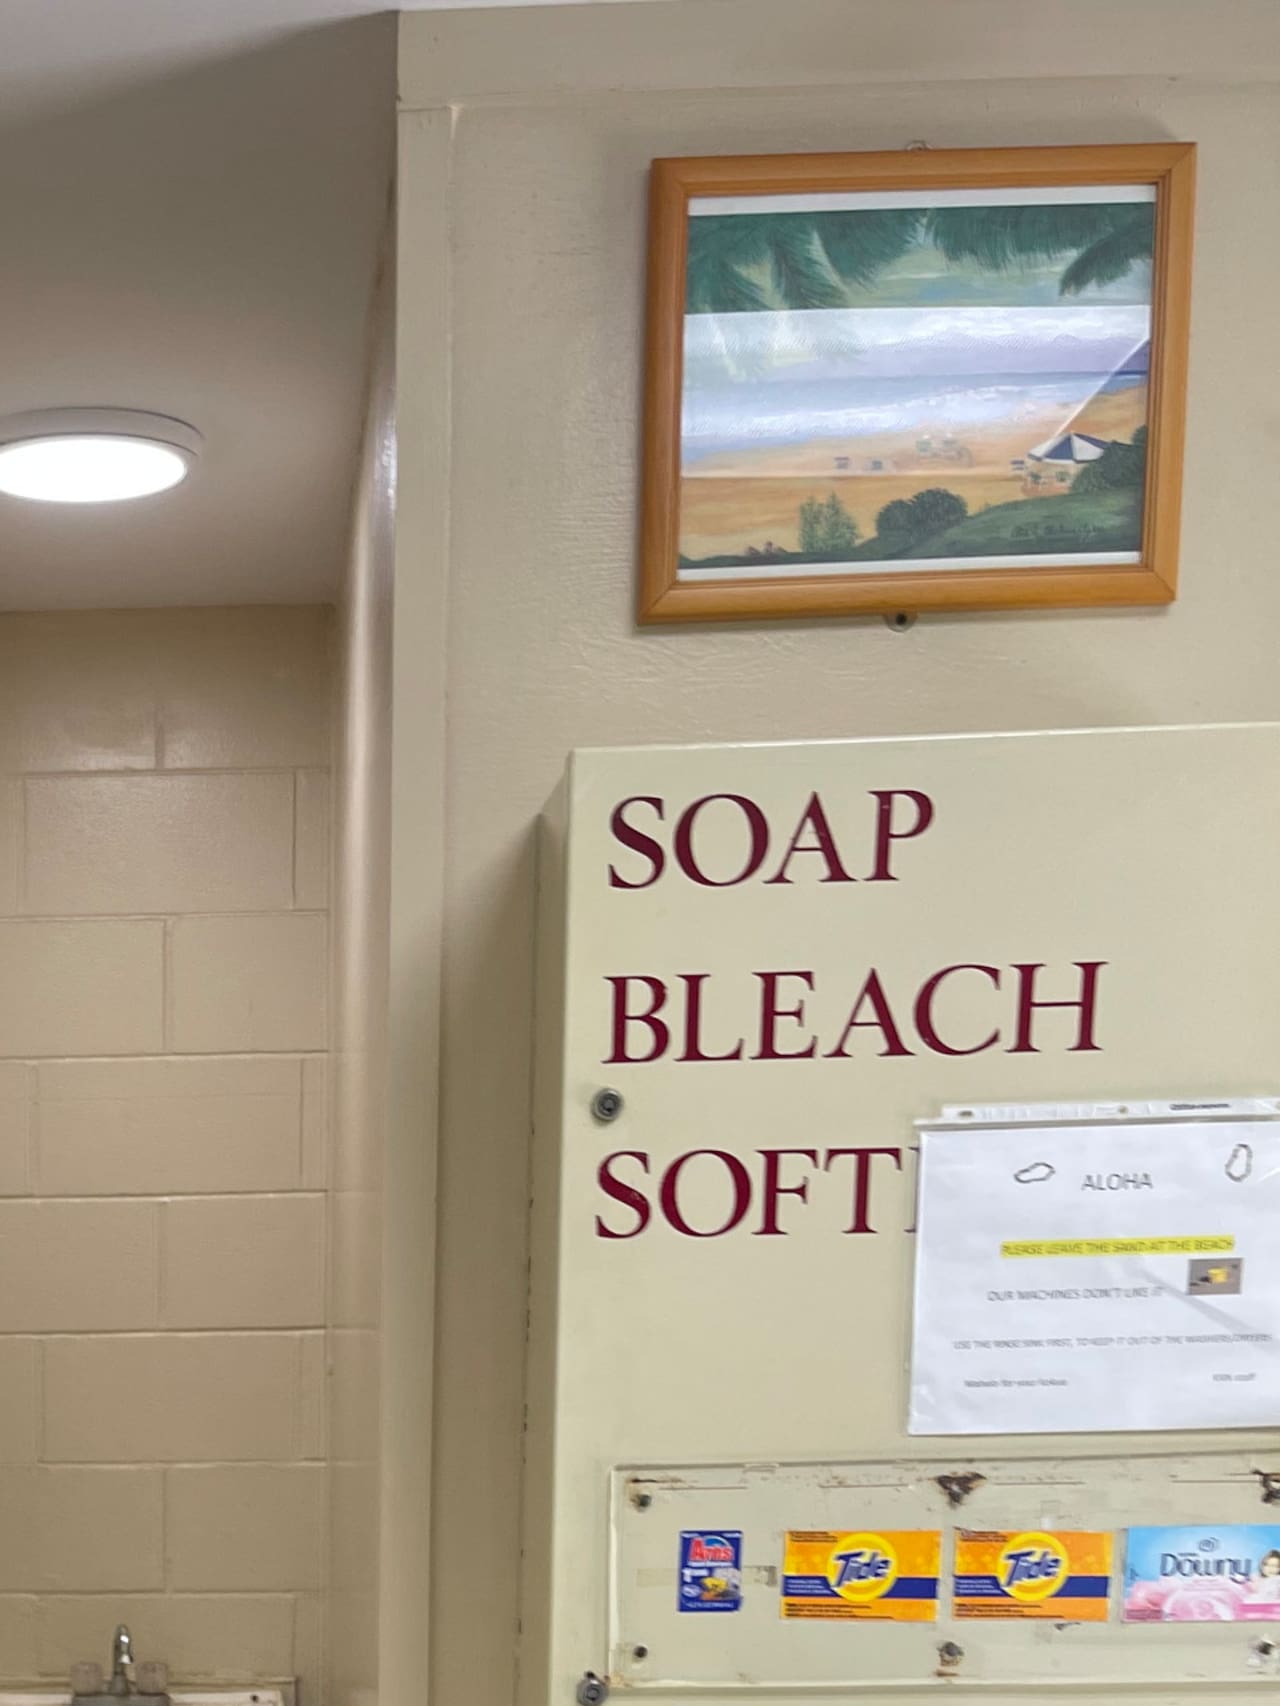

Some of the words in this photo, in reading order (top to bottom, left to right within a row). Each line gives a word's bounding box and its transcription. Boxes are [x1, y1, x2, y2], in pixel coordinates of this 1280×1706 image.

[608, 789, 933, 889] SOAP
[601, 961, 1108, 1064] BLEACH
[595, 1146, 919, 1239] SOFT
[1081, 1172, 1153, 1192] ALOHA
[830, 1550, 892, 1588] Tide
[1002, 1550, 1061, 1588] Tide
[1160, 1552, 1251, 1585] Downy
